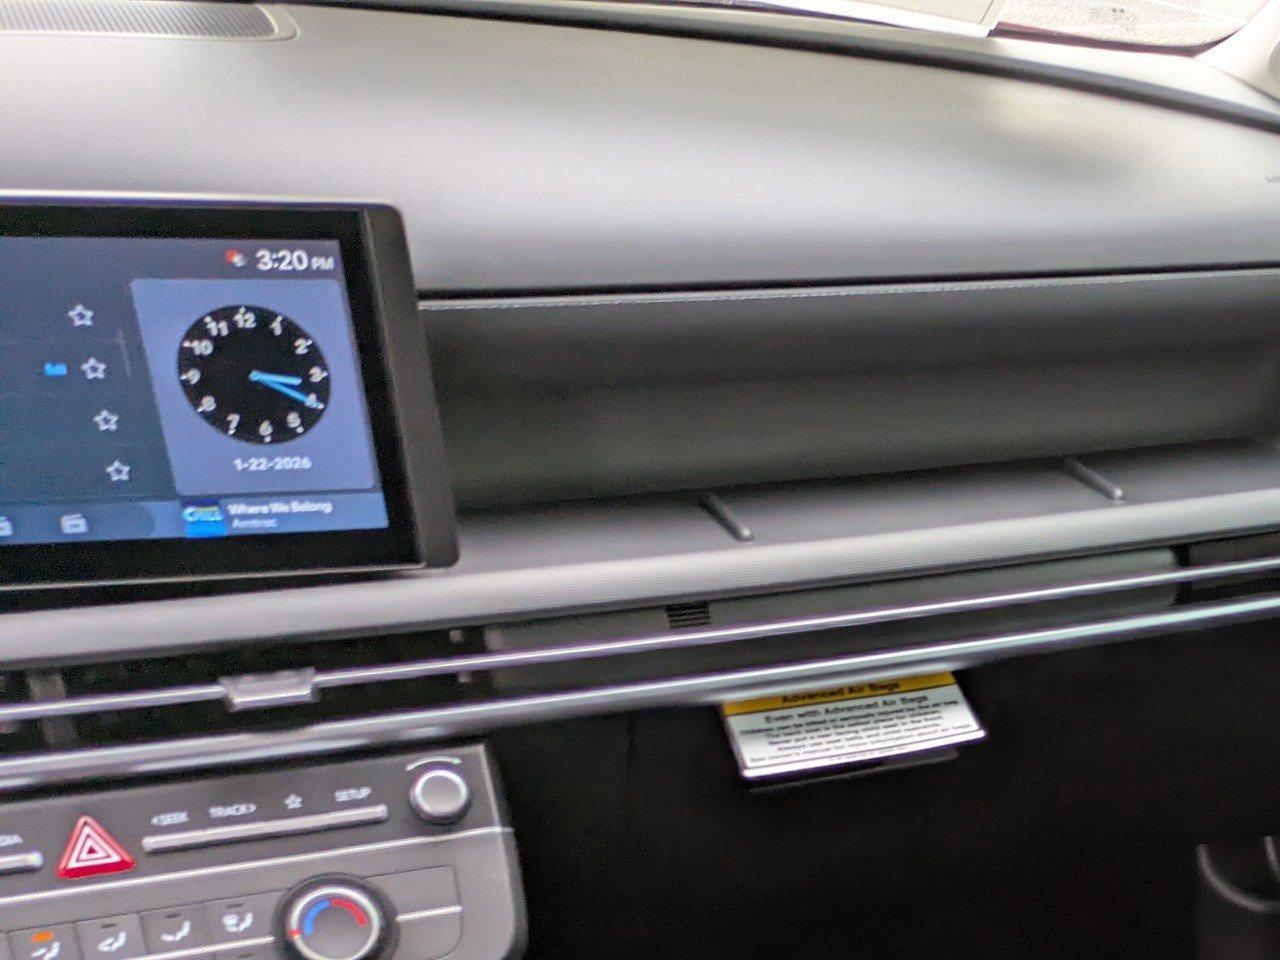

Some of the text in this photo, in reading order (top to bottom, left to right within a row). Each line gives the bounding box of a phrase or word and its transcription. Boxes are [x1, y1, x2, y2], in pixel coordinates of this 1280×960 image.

[255, 249, 308, 271] 3:20
[233, 311, 256, 328] 12
[270, 318, 282, 336] 1
[206, 320, 229, 337] 11
[190, 339, 214, 356] 10
[294, 337, 309, 354] 2
[187, 368, 201, 385] 9
[308, 365, 322, 383] 3
[201, 395, 217, 412] 8
[227, 412, 240, 430] 7
[258, 419, 273, 436] 6
[286, 411, 301, 428] 5
[233, 455, 313, 472] 1-22-2026
